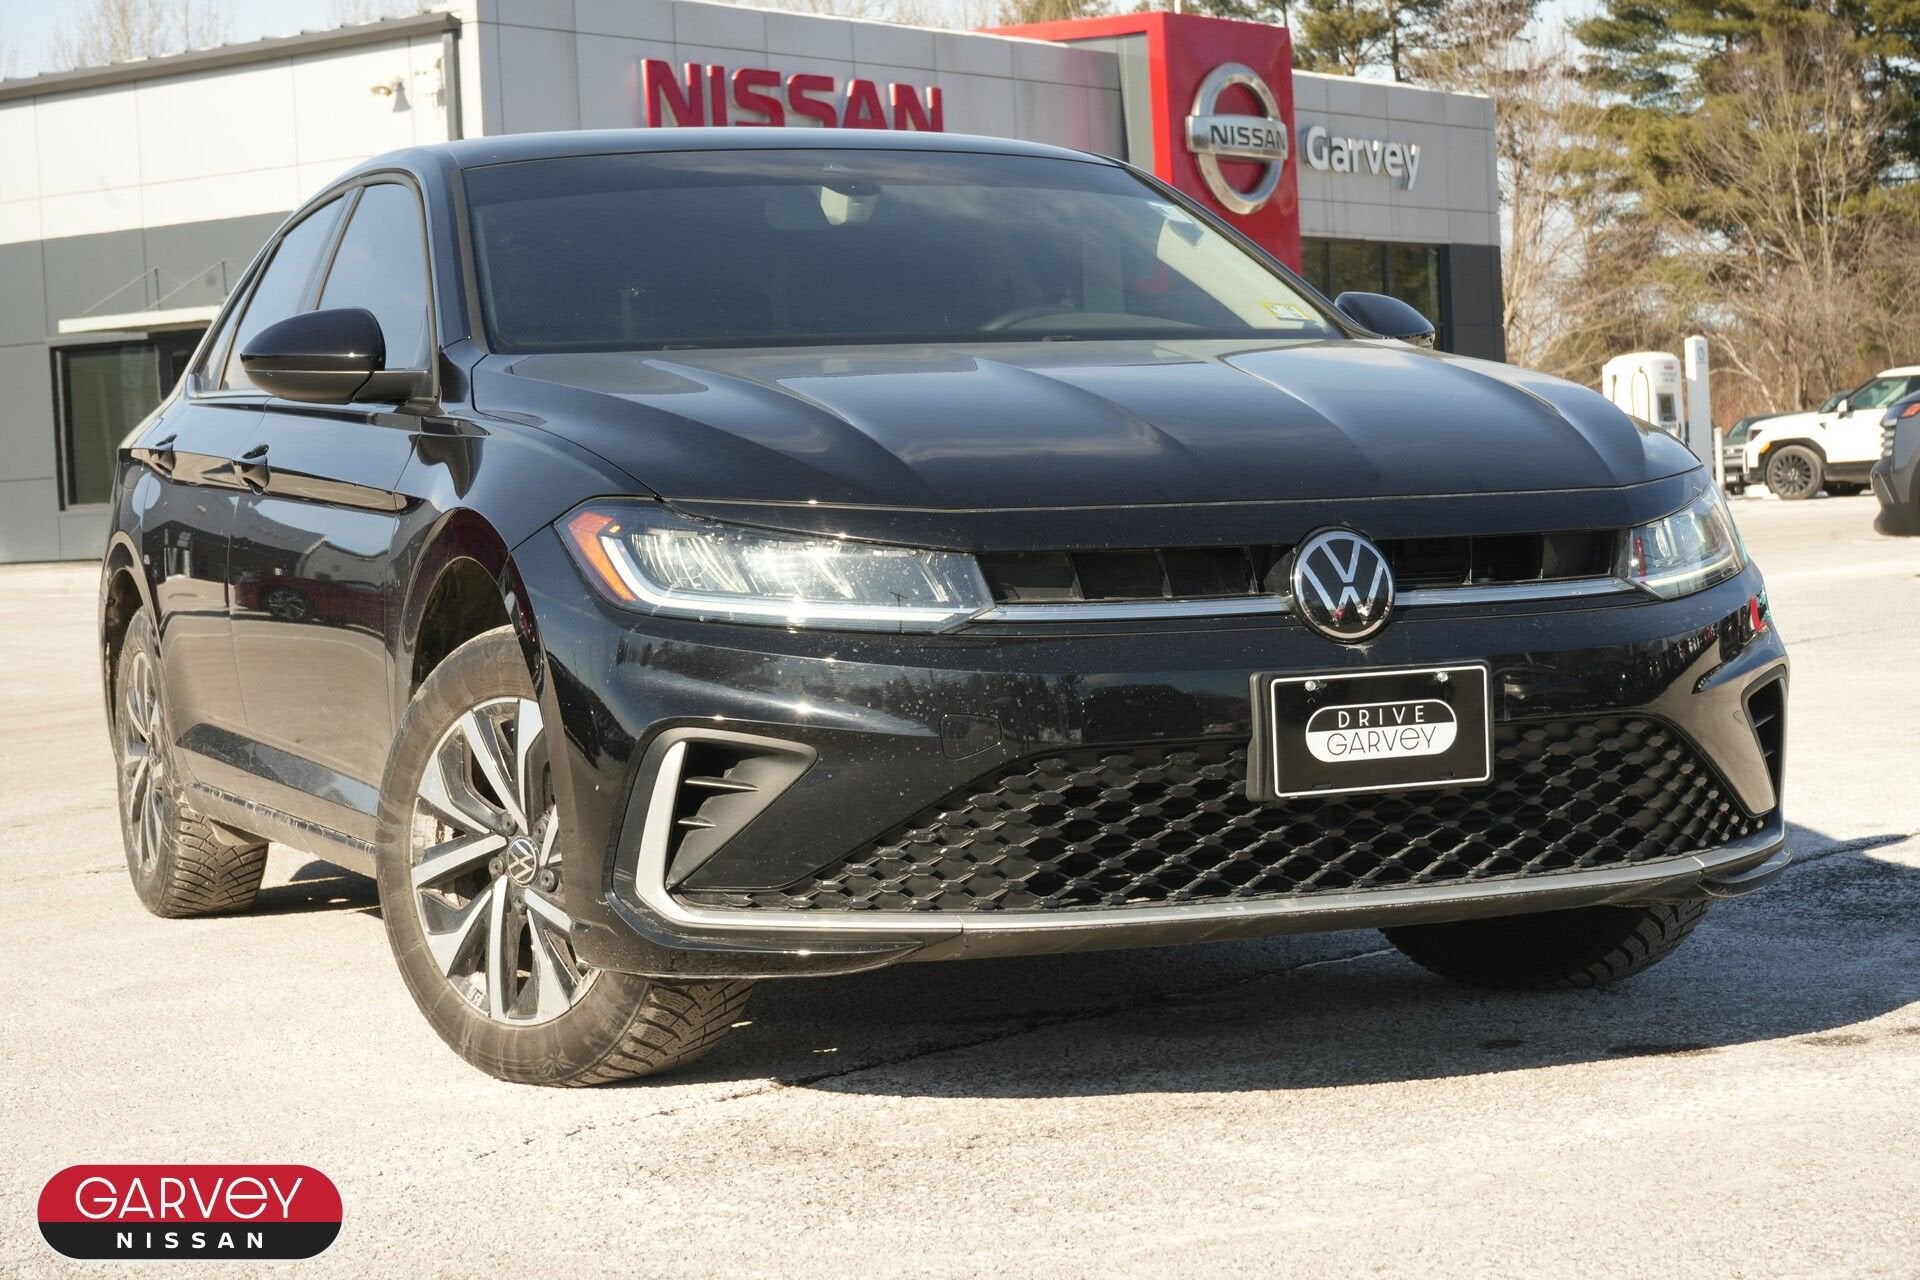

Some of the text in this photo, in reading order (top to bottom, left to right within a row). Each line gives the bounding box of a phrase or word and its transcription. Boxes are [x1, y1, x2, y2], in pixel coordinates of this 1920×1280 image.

[641, 58, 944, 133] NISSAN
[1210, 125, 1286, 151] NISSAN
[1306, 126, 1421, 191] Garvey
[1338, 705, 1425, 728] DRIVE
